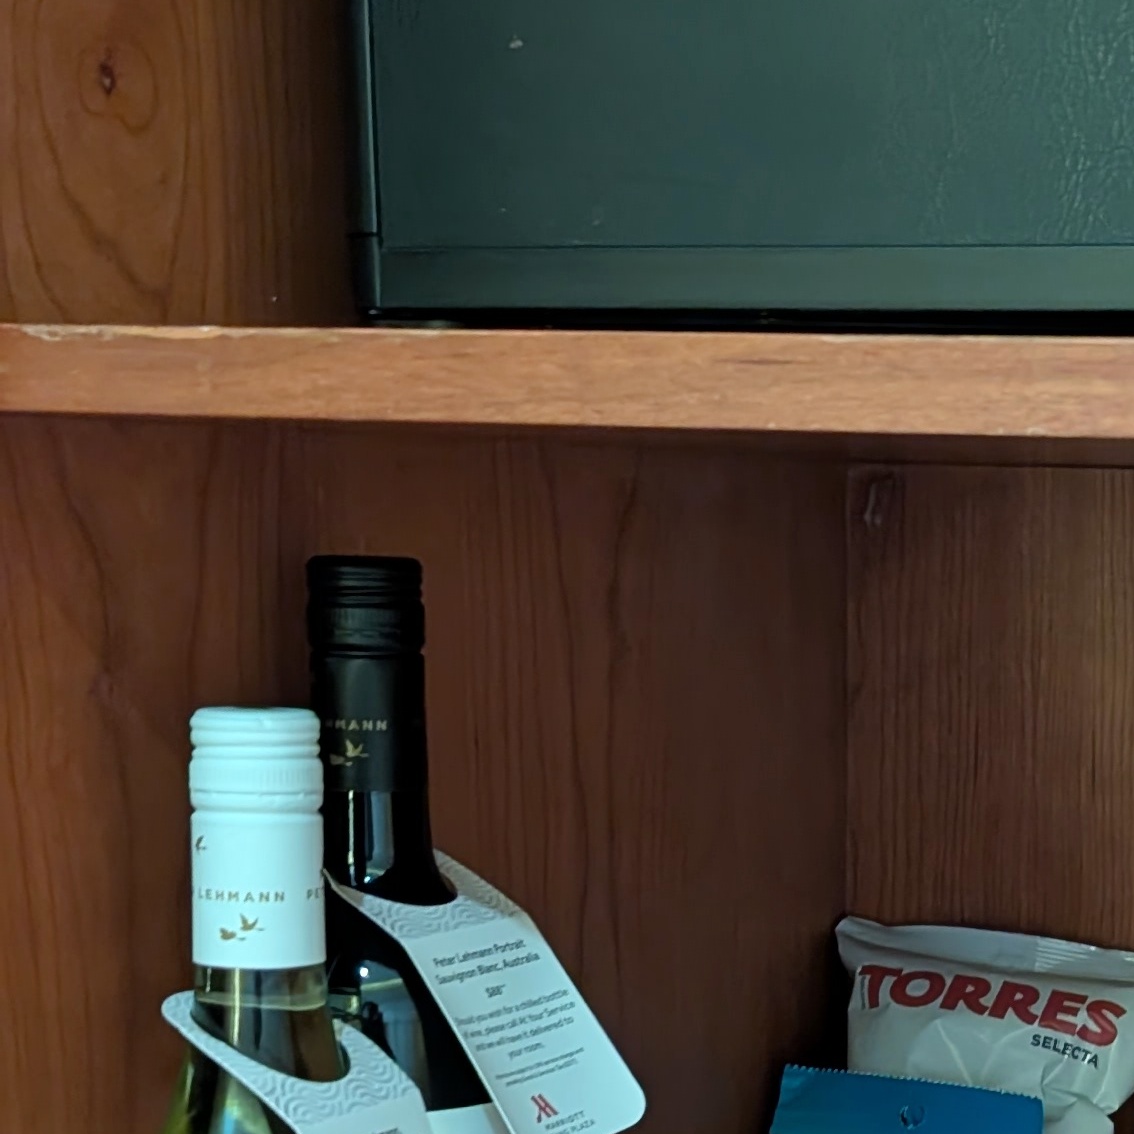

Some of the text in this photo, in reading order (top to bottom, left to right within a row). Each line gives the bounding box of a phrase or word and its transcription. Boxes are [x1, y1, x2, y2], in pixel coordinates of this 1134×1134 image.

[198, 888, 285, 903] LEHMANN
[433, 953, 456, 968] Peter
[435, 968, 477, 985] Sauvignon
[858, 964, 1127, 1047] TORRES
[1030, 1034, 1099, 1069] SELECTA
